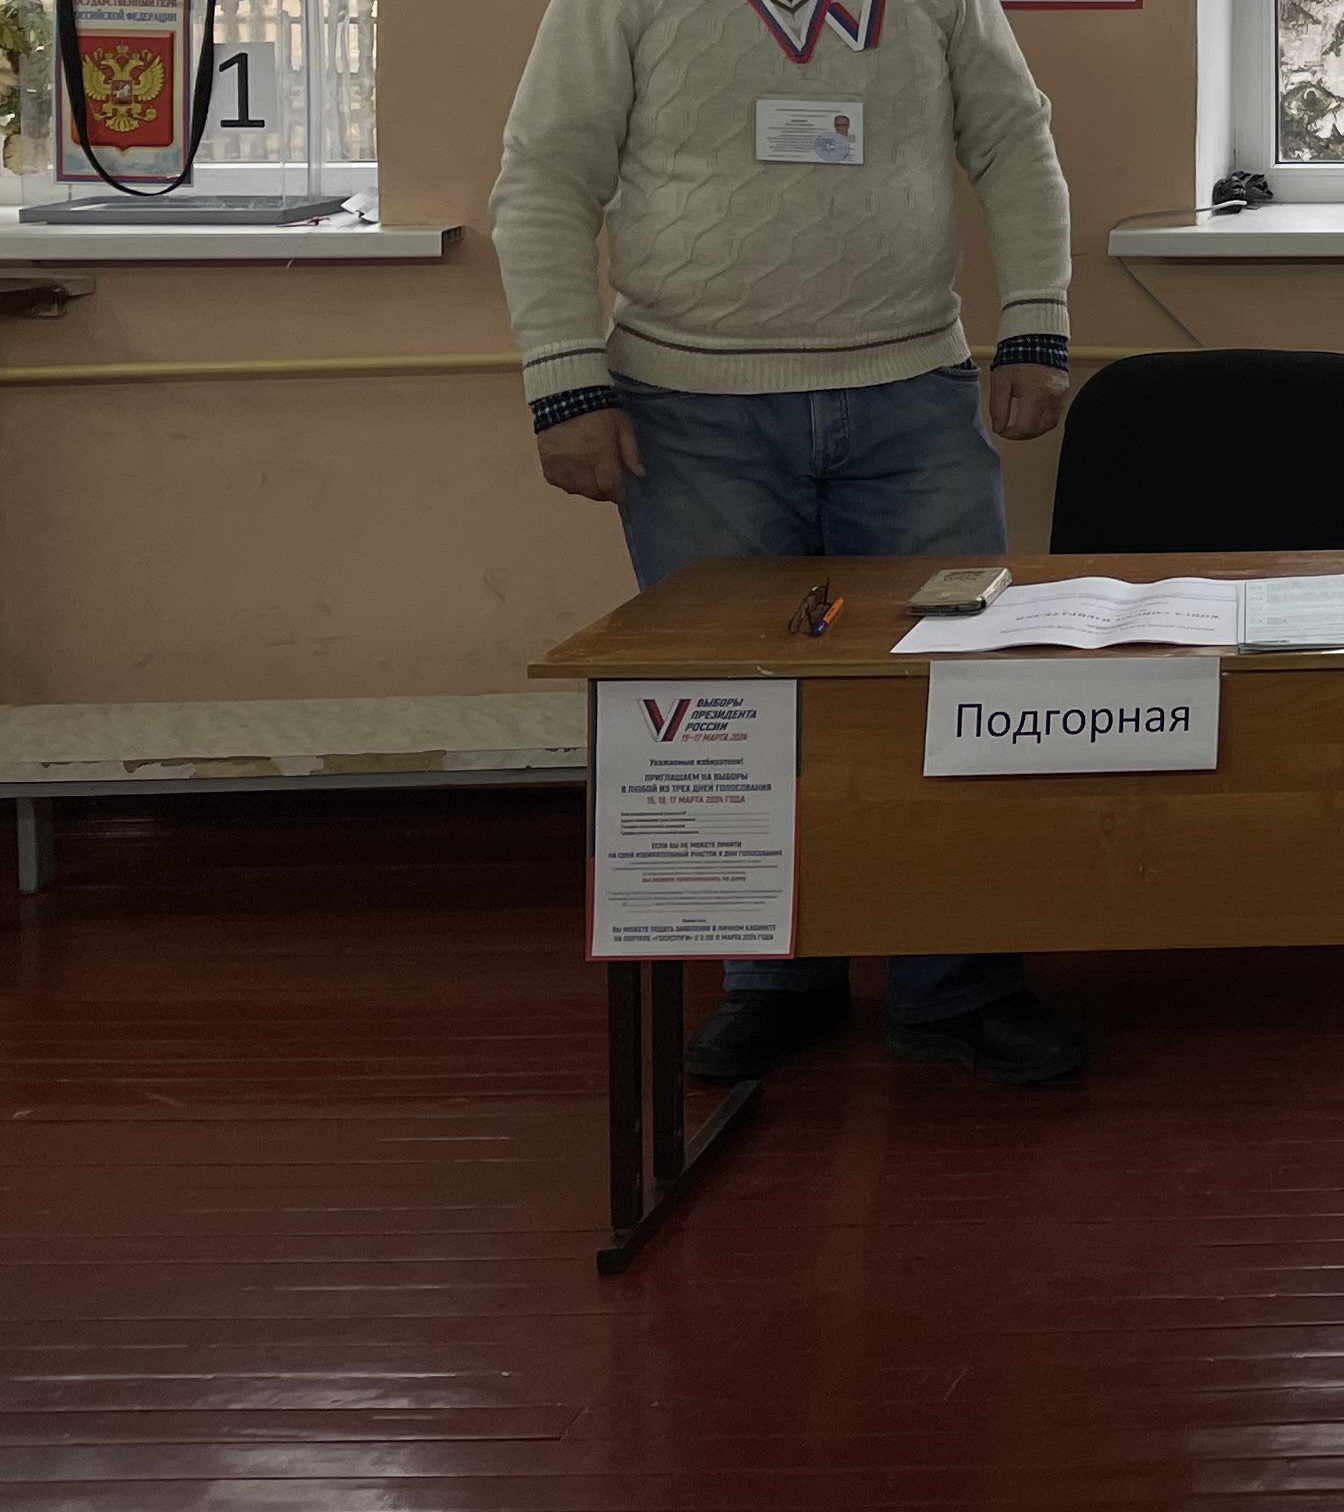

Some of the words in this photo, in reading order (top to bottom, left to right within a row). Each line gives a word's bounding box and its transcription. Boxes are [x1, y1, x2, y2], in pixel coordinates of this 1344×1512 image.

[218, 51, 265, 128] 1
[696, 698, 744, 708] ВЫБОРЫ
[691, 710, 757, 720] ПРЕЗИДЕНТА
[685, 722, 729, 731] РОССИИ
[955, 703, 1191, 744] Подгорная
